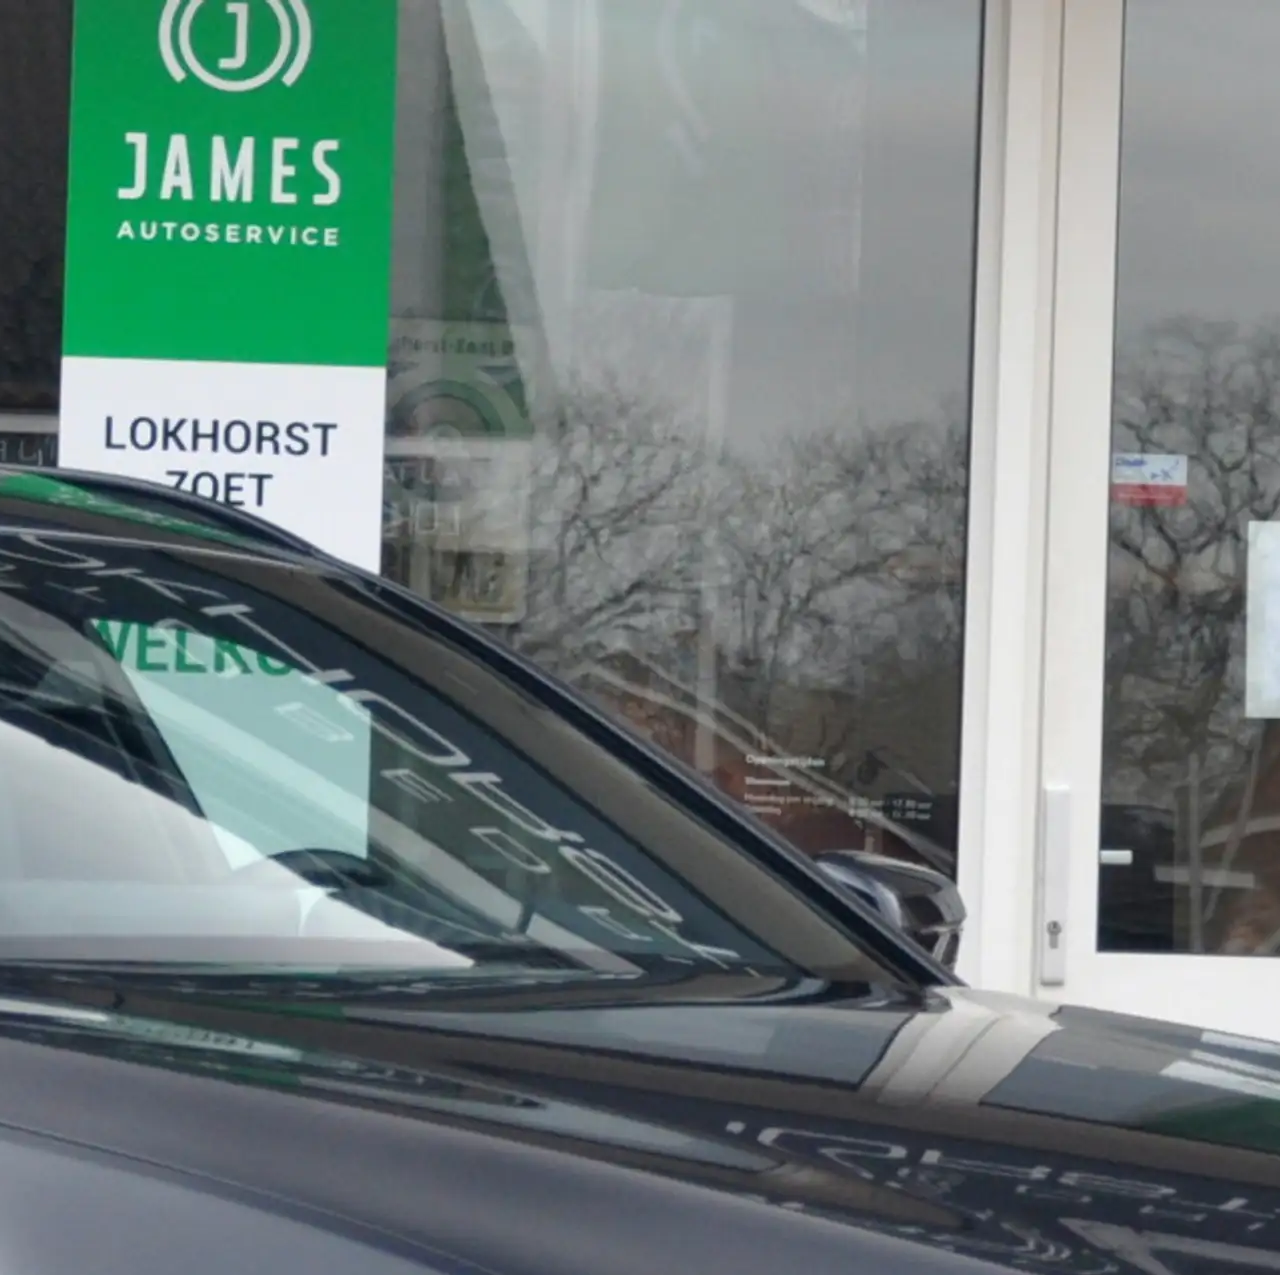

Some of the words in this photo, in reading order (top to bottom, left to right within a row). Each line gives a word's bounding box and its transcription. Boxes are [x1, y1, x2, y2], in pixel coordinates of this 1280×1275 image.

[117, 132, 342, 206] JAMES
[117, 221, 340, 246] AUTOSERVICE
[105, 415, 338, 457] LOKHORST
[165, 469, 274, 507] ZOET
